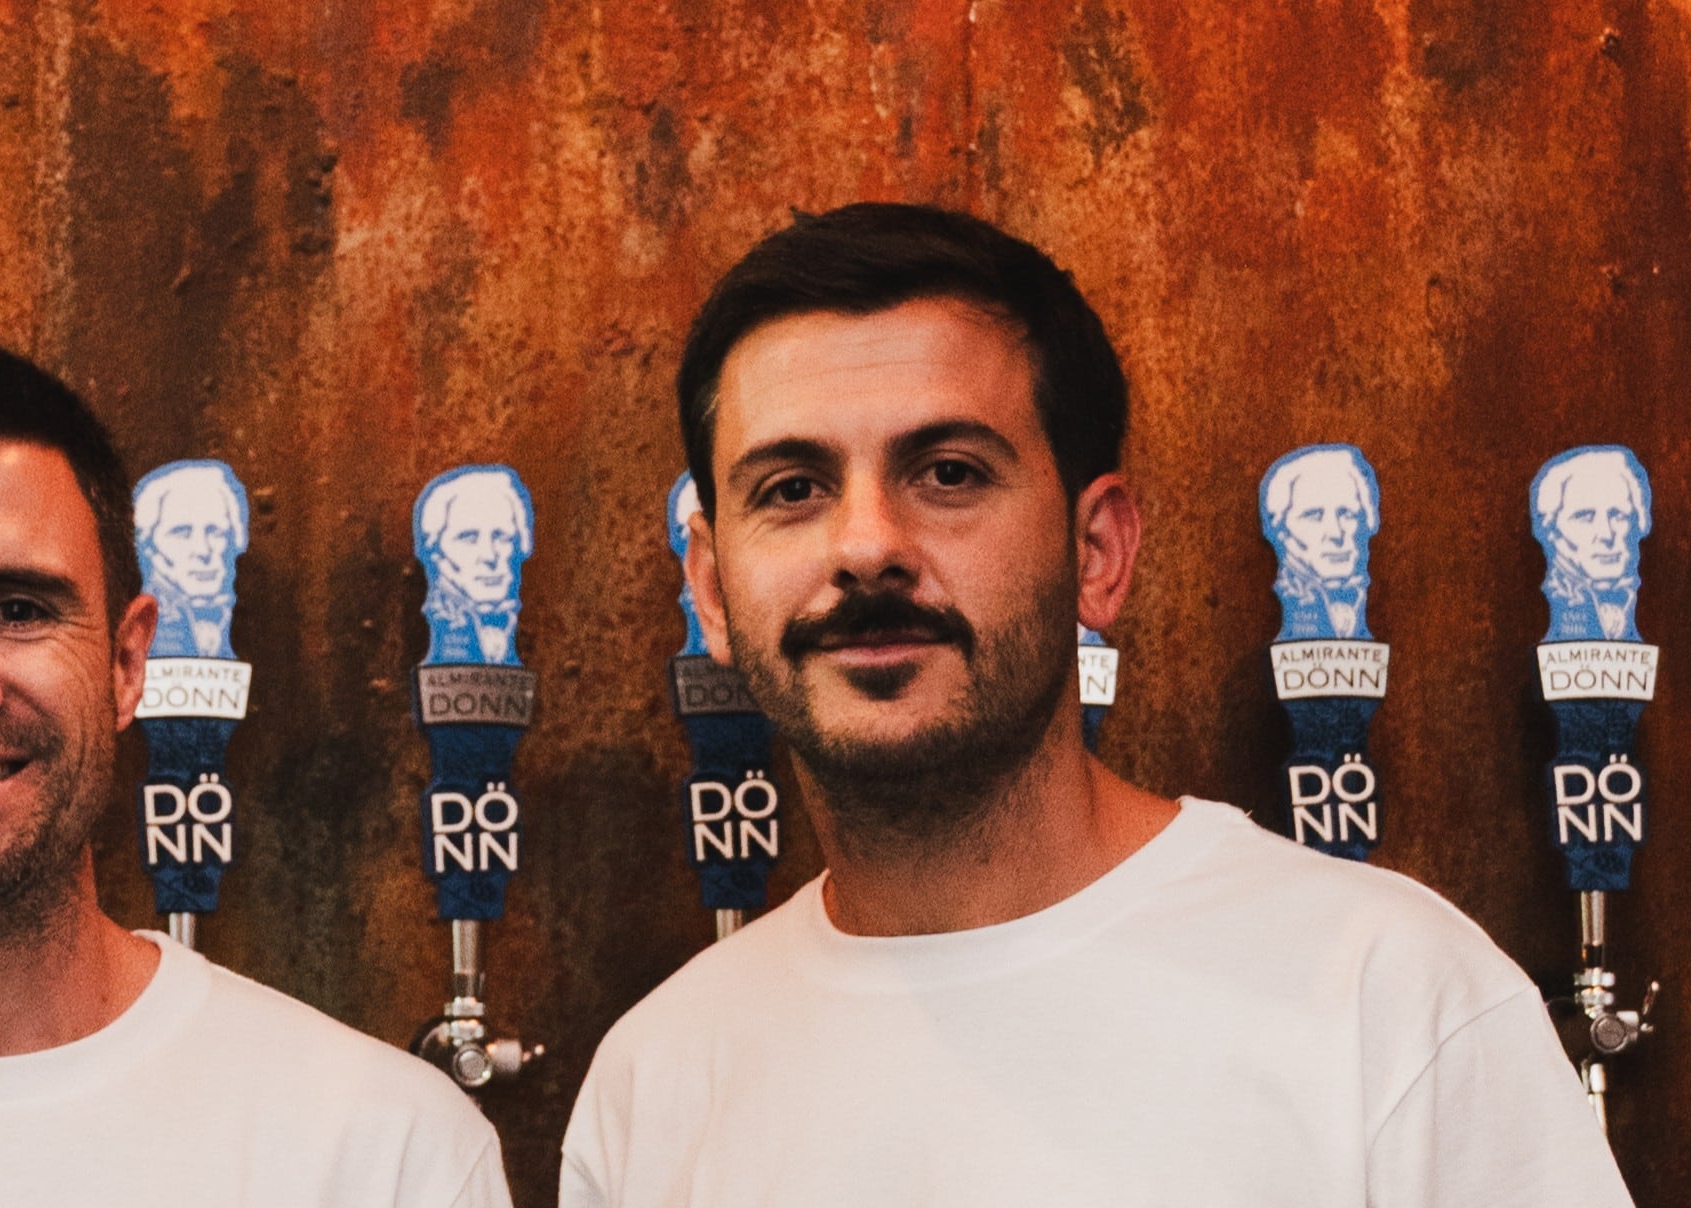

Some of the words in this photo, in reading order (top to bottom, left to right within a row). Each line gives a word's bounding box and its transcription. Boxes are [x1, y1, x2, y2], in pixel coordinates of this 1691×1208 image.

[146, 665, 244, 681] LMIRANTE
[1278, 647, 1384, 663] ALMIRANTE
[1546, 648, 1653, 666] ALMIRANTE
[1282, 662, 1381, 691] DÖNN
[1549, 662, 1650, 692] DÖNN
[143, 772, 233, 825] DÖ
[689, 769, 778, 822] DÖ
[1288, 752, 1376, 805] DÖ
[1553, 753, 1642, 806] DÖ
[430, 781, 519, 833] DÖ
[1291, 802, 1377, 844] NN
[1556, 803, 1643, 844] NN
[145, 823, 233, 865] NN
[434, 831, 519, 874] NN
[693, 820, 778, 861] NN
